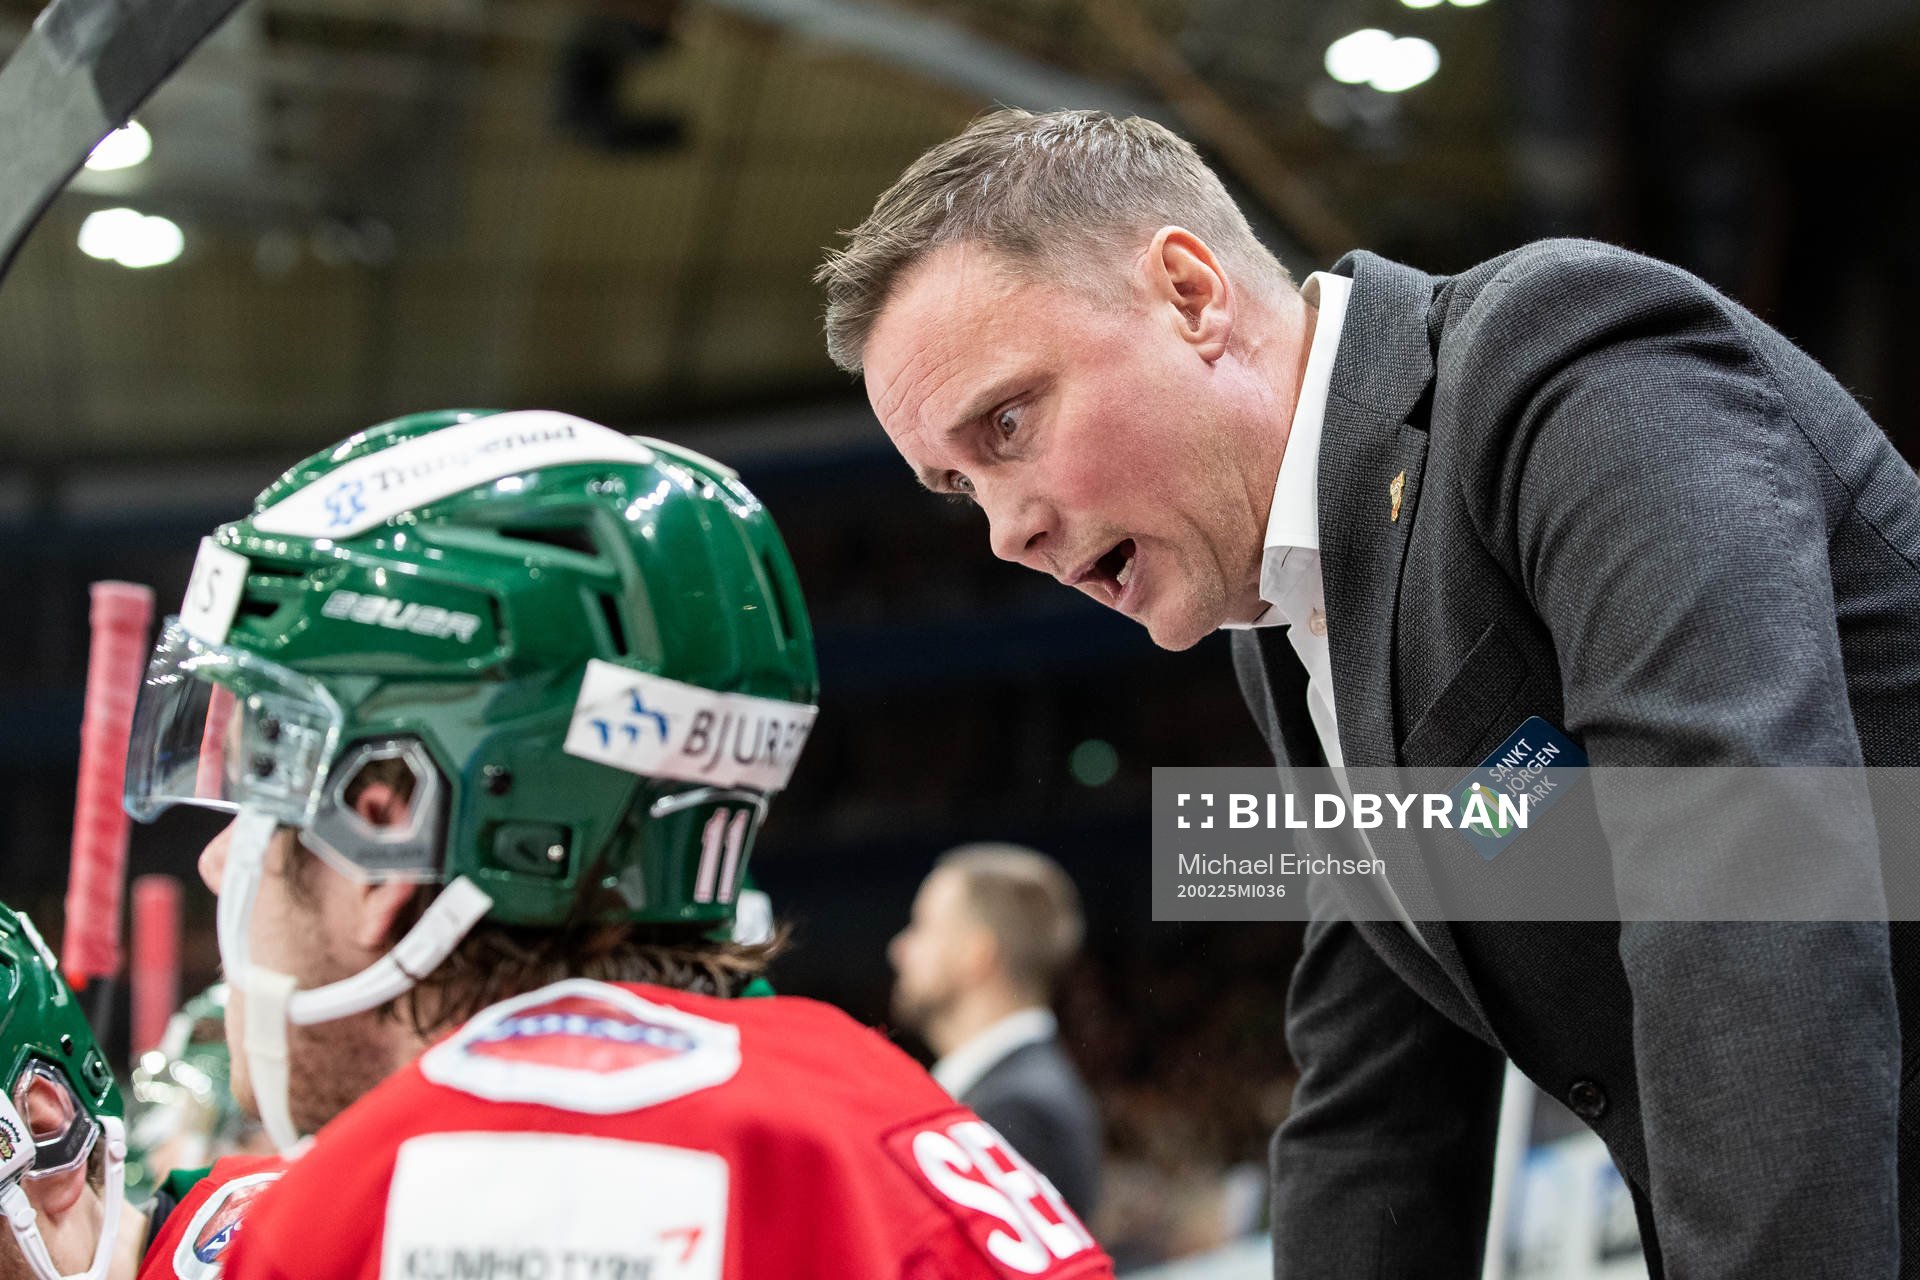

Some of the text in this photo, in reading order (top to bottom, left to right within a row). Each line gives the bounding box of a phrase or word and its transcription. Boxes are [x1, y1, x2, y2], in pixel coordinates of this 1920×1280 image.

[320, 589, 482, 644] BAUER
[1489, 738, 1533, 782] SANKT
[1505, 742, 1560, 798] JÖRGEN
[1519, 775, 1558, 812] ARK
[693, 806, 750, 904] 11
